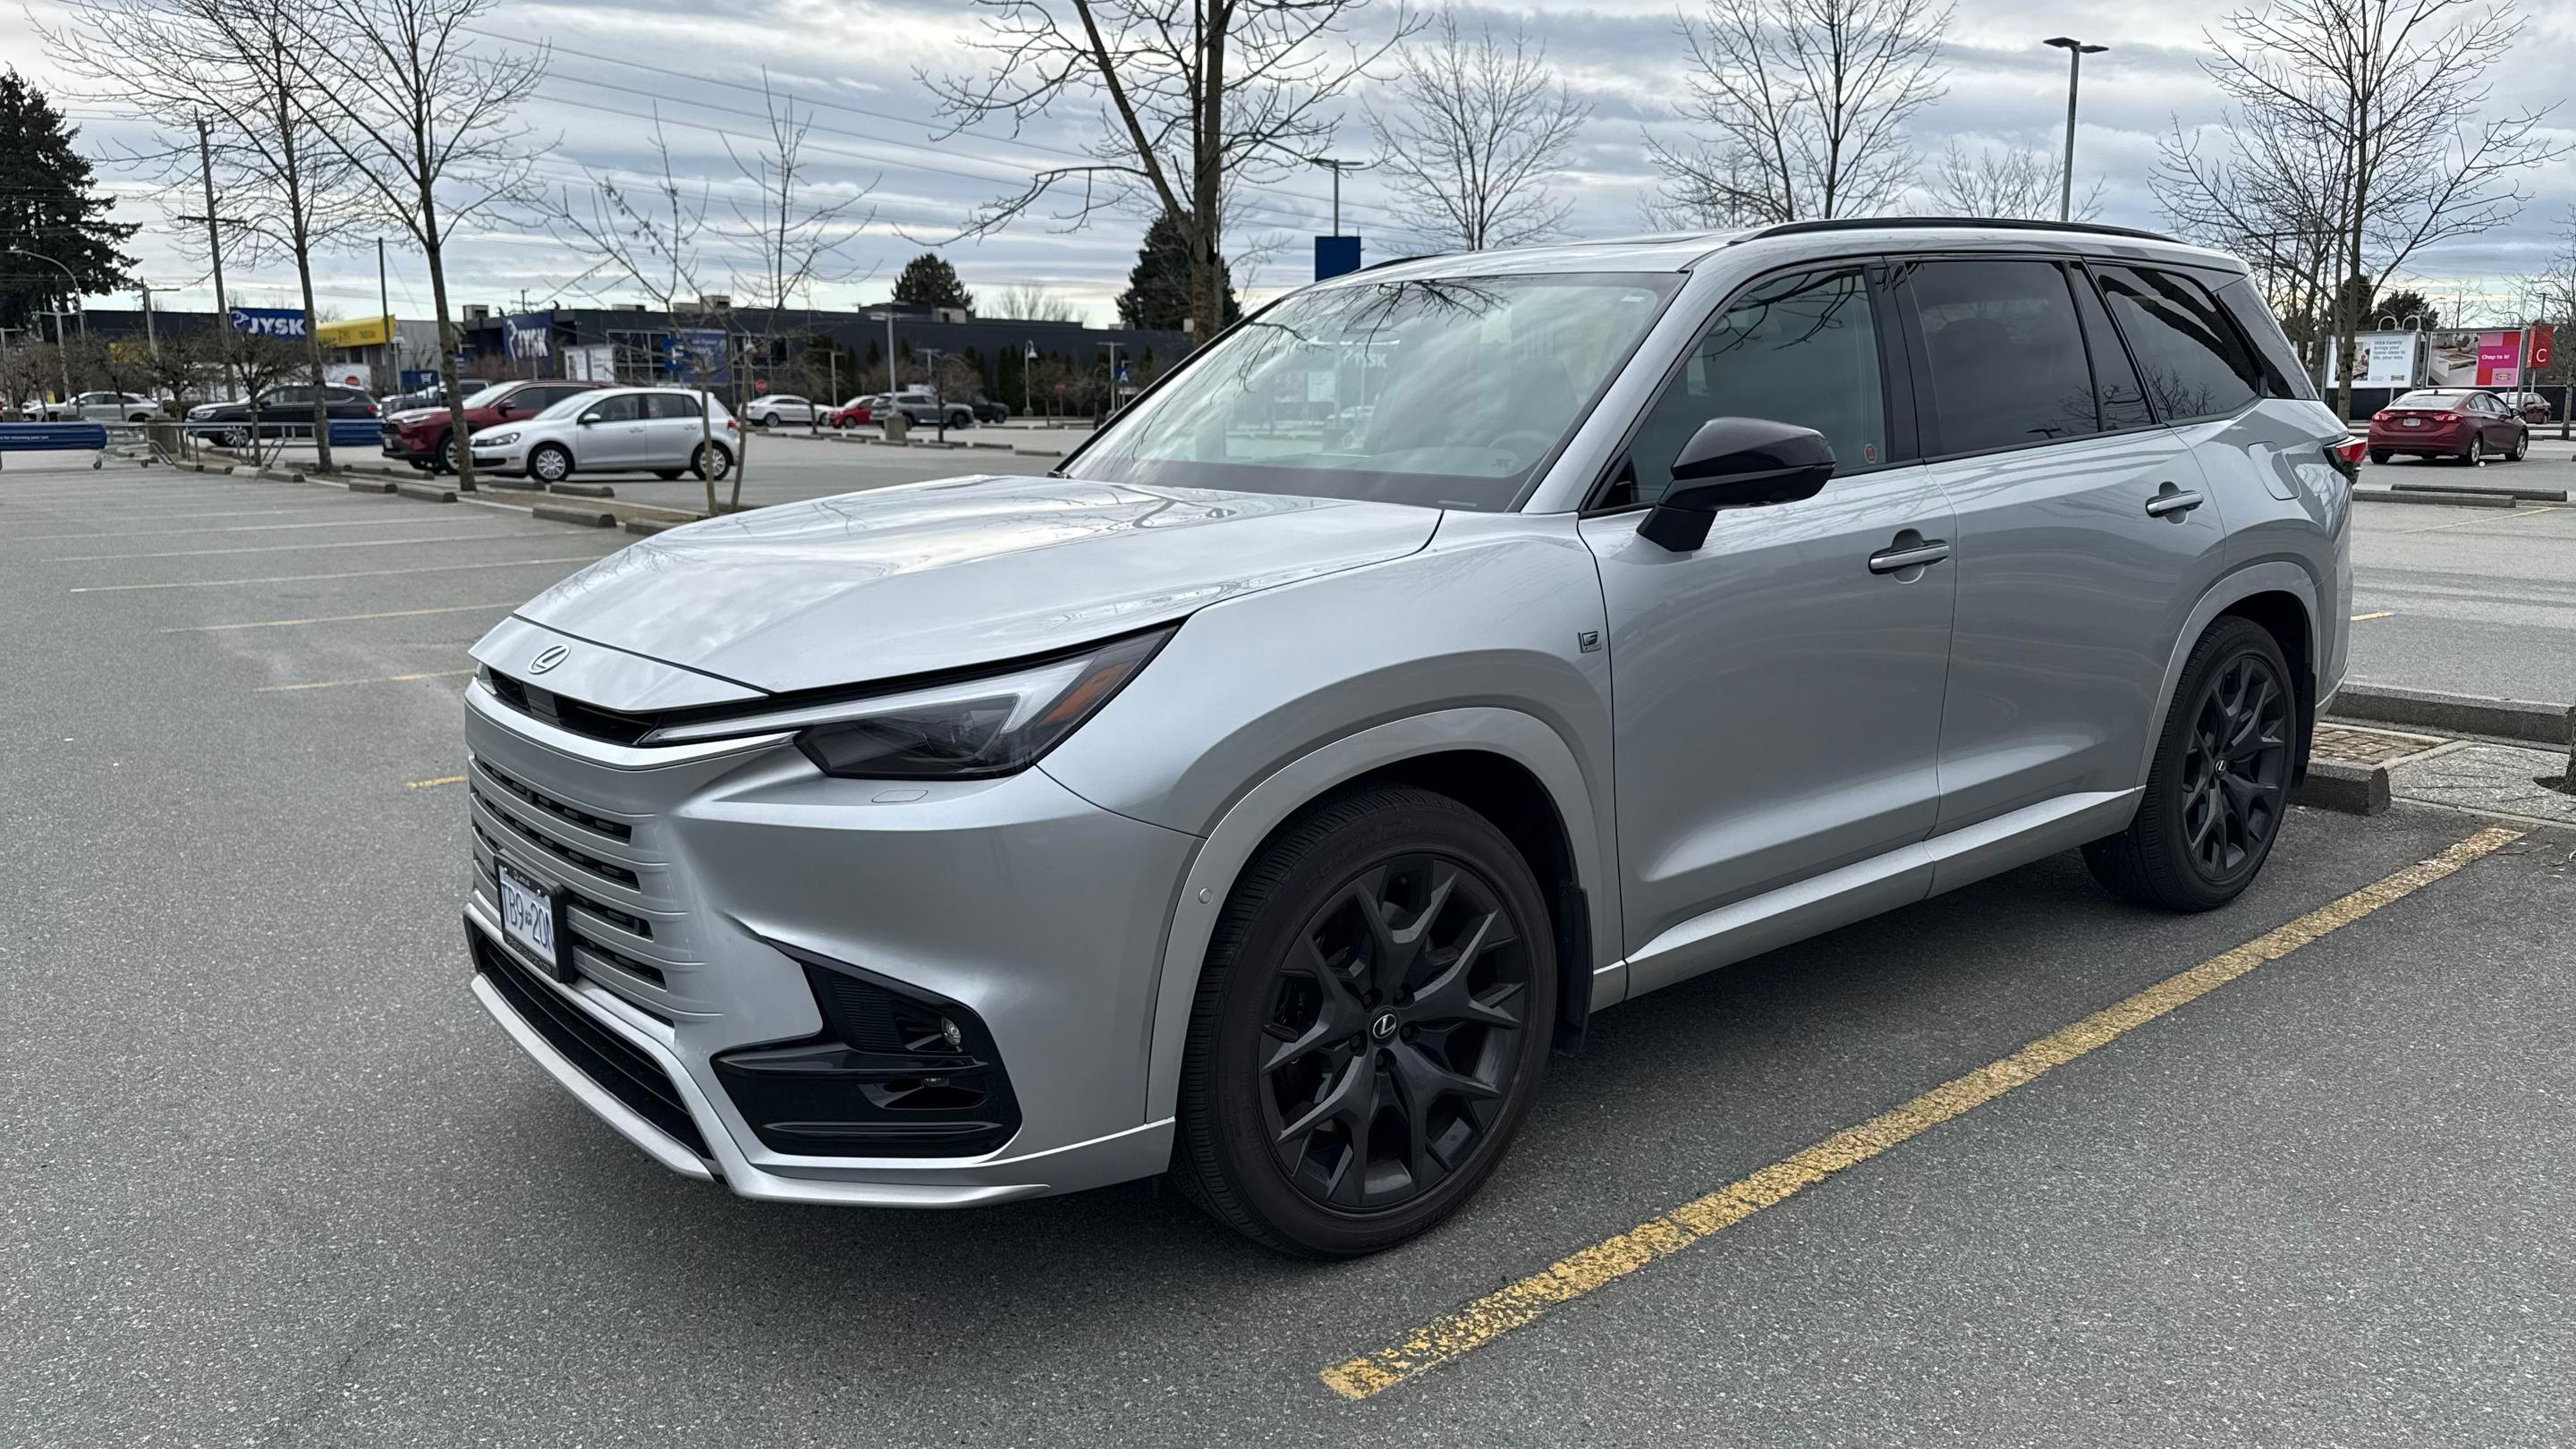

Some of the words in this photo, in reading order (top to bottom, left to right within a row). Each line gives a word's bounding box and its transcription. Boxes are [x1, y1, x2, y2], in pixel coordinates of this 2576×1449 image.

[249, 317, 306, 335] JYSK
[517, 327, 548, 358] JYSK
[2536, 348, 2547, 362] C
[501, 882, 524, 931] TB9
